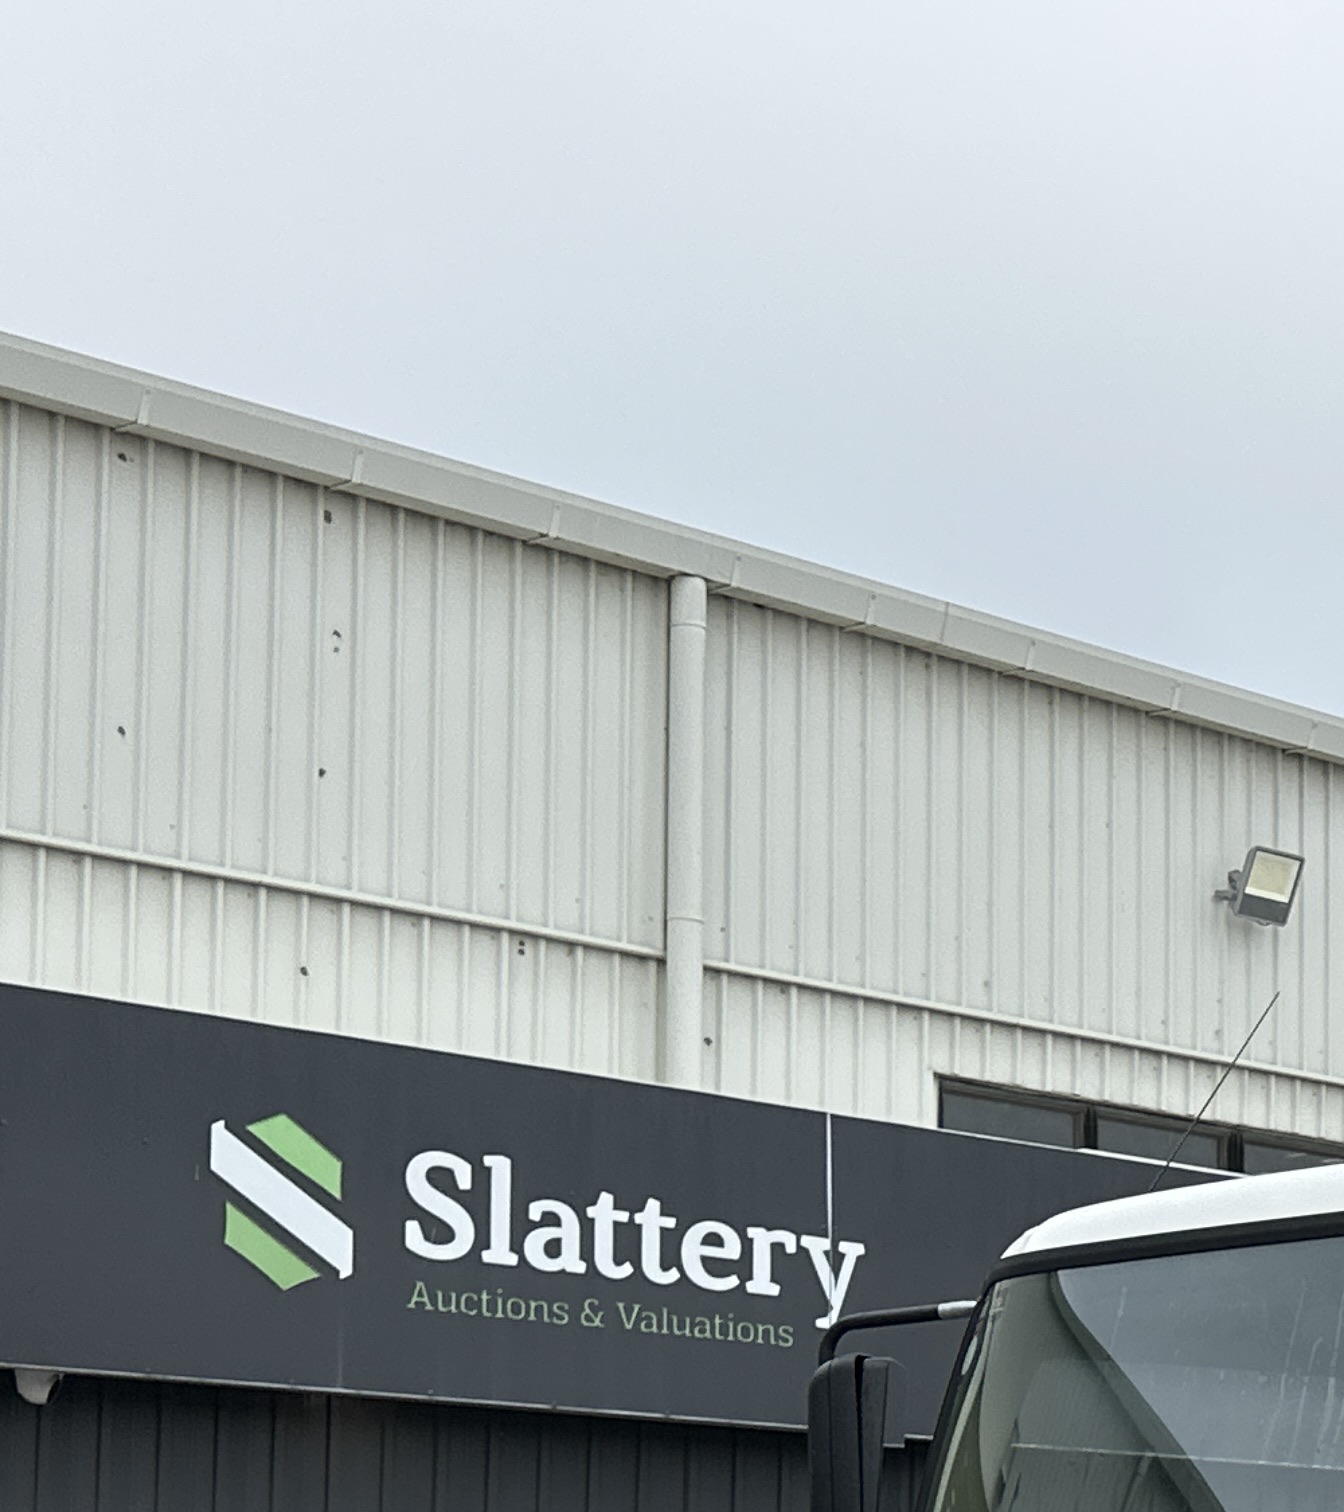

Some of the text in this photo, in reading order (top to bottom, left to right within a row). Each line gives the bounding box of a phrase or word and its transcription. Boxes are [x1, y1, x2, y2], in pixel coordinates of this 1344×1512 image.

[404, 1149, 866, 1330] Slattery
[407, 1280, 795, 1348] Auctions & Valuations
